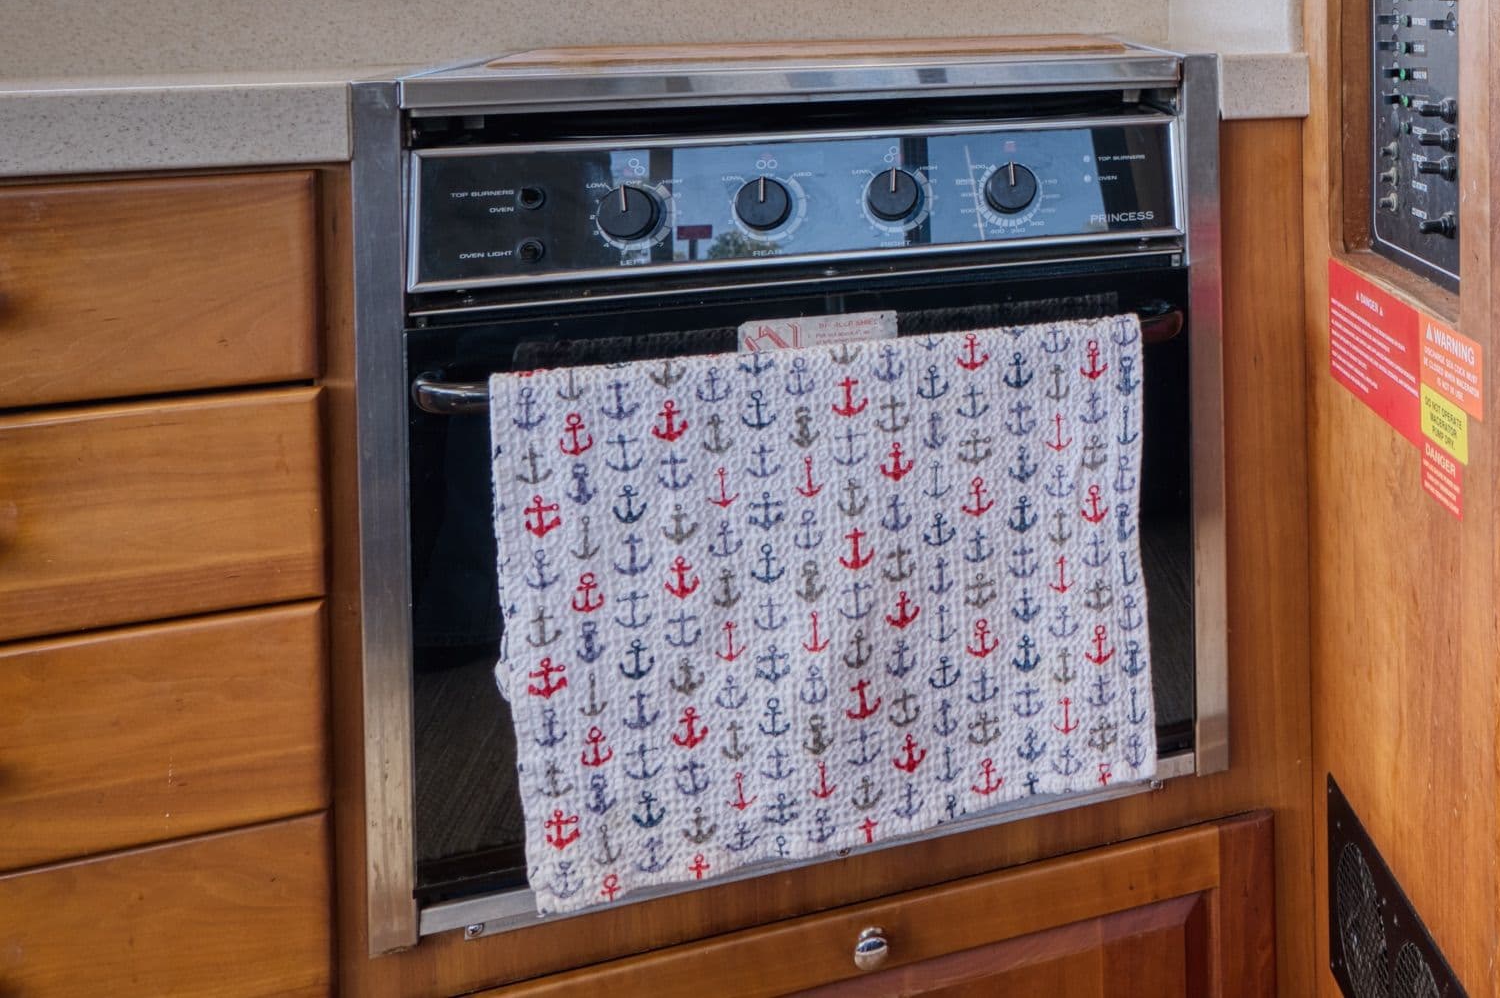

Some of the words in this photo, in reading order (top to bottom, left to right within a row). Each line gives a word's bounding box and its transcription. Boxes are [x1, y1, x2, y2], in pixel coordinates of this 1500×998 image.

[470, 189, 515, 197] BURNERS
[489, 206, 514, 214] OVEN
[1090, 210, 1154, 225] PRINCESS
[487, 250, 513, 258] LIGHT
[752, 249, 783, 257] REAR
[620, 258, 648, 266] LEFT
[1433, 326, 1475, 367] WARNING
[1425, 396, 1432, 408] DO
[1432, 401, 1441, 413] NOT
[1441, 407, 1462, 430] OPERATE
[1430, 413, 1457, 438] MACERATOR
[1432, 425, 1444, 440] PUMP
[1425, 442, 1456, 478] DANGER
